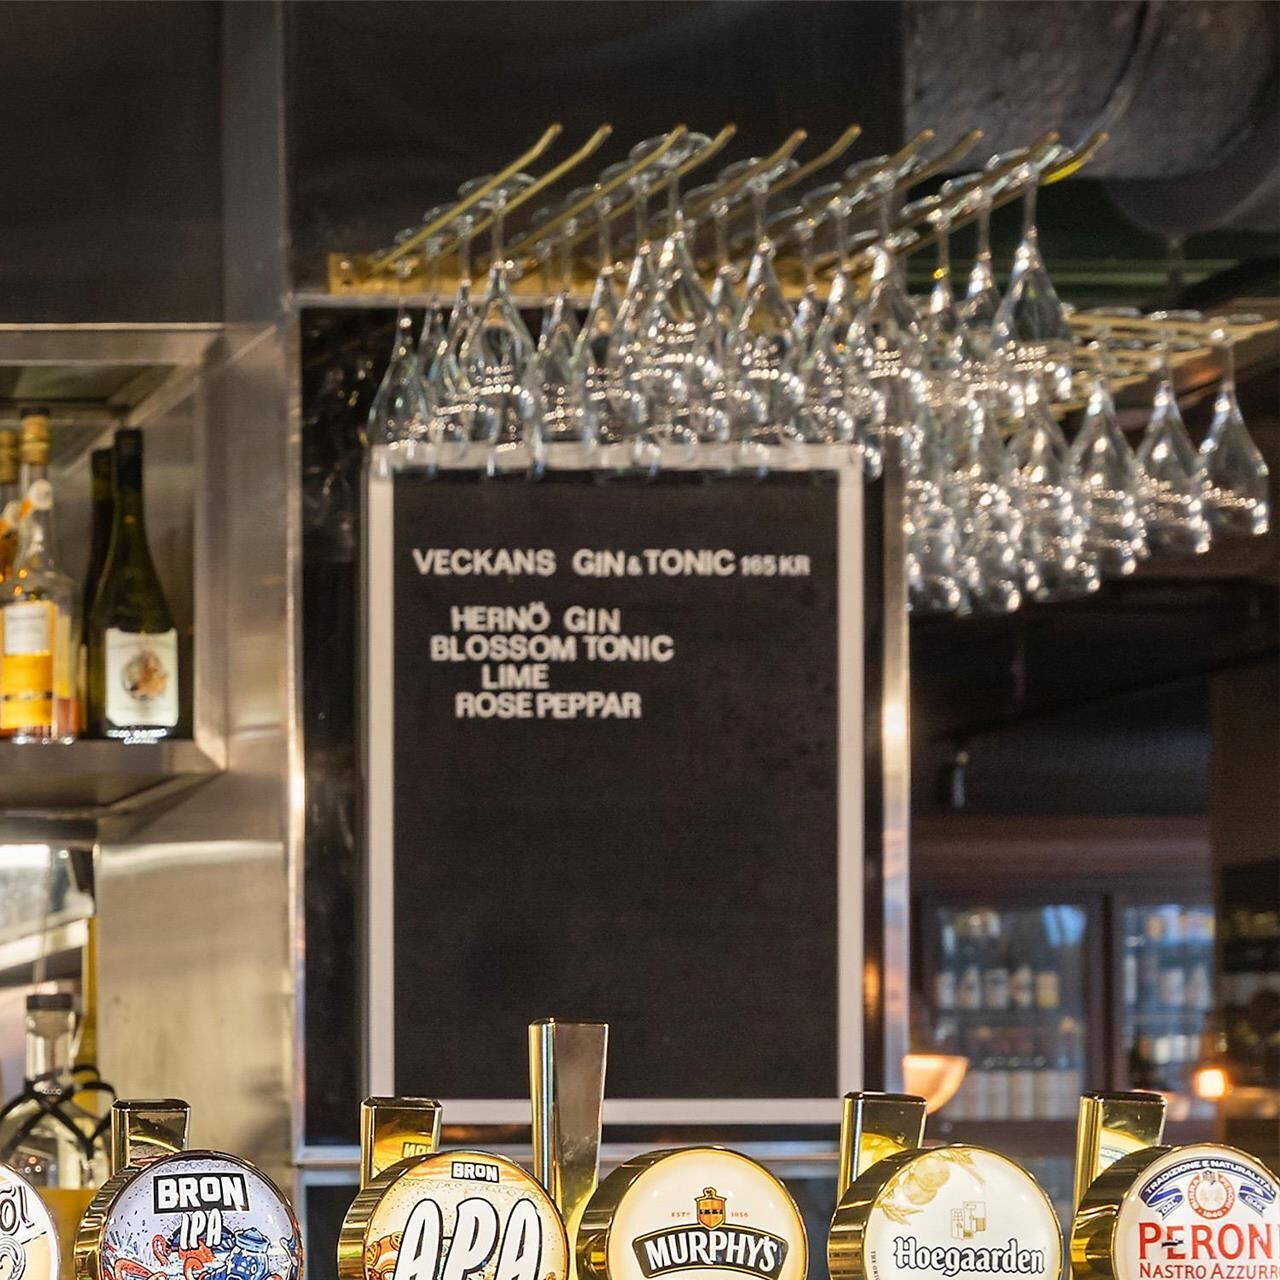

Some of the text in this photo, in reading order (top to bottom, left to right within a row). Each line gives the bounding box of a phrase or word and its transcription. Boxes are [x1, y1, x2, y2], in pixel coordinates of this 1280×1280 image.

[412, 548, 557, 576] VECKANS
[450, 601, 622, 634] HERNÖ GIN
[430, 634, 674, 662] BLOSSOM TONIC
[482, 663, 550, 689] LIME
[455, 690, 642, 719] ROSE PEPPAR
[452, 1161, 500, 1183] BRON
[1144, 1159, 1202, 1194] TRADIZIONE
[1202, 1160, 1210, 1168] E
[157, 1175, 245, 1212] BRON
[1161, 1199, 1177, 1215] DAL
[179, 1208, 223, 1250] IPA
[1138, 1222, 1280, 1261] PERON
[644, 1230, 778, 1273] MURPHY'S
[893, 1235, 1046, 1277] Hoegaarden
[1140, 1262, 1207, 1280] NASTRO
